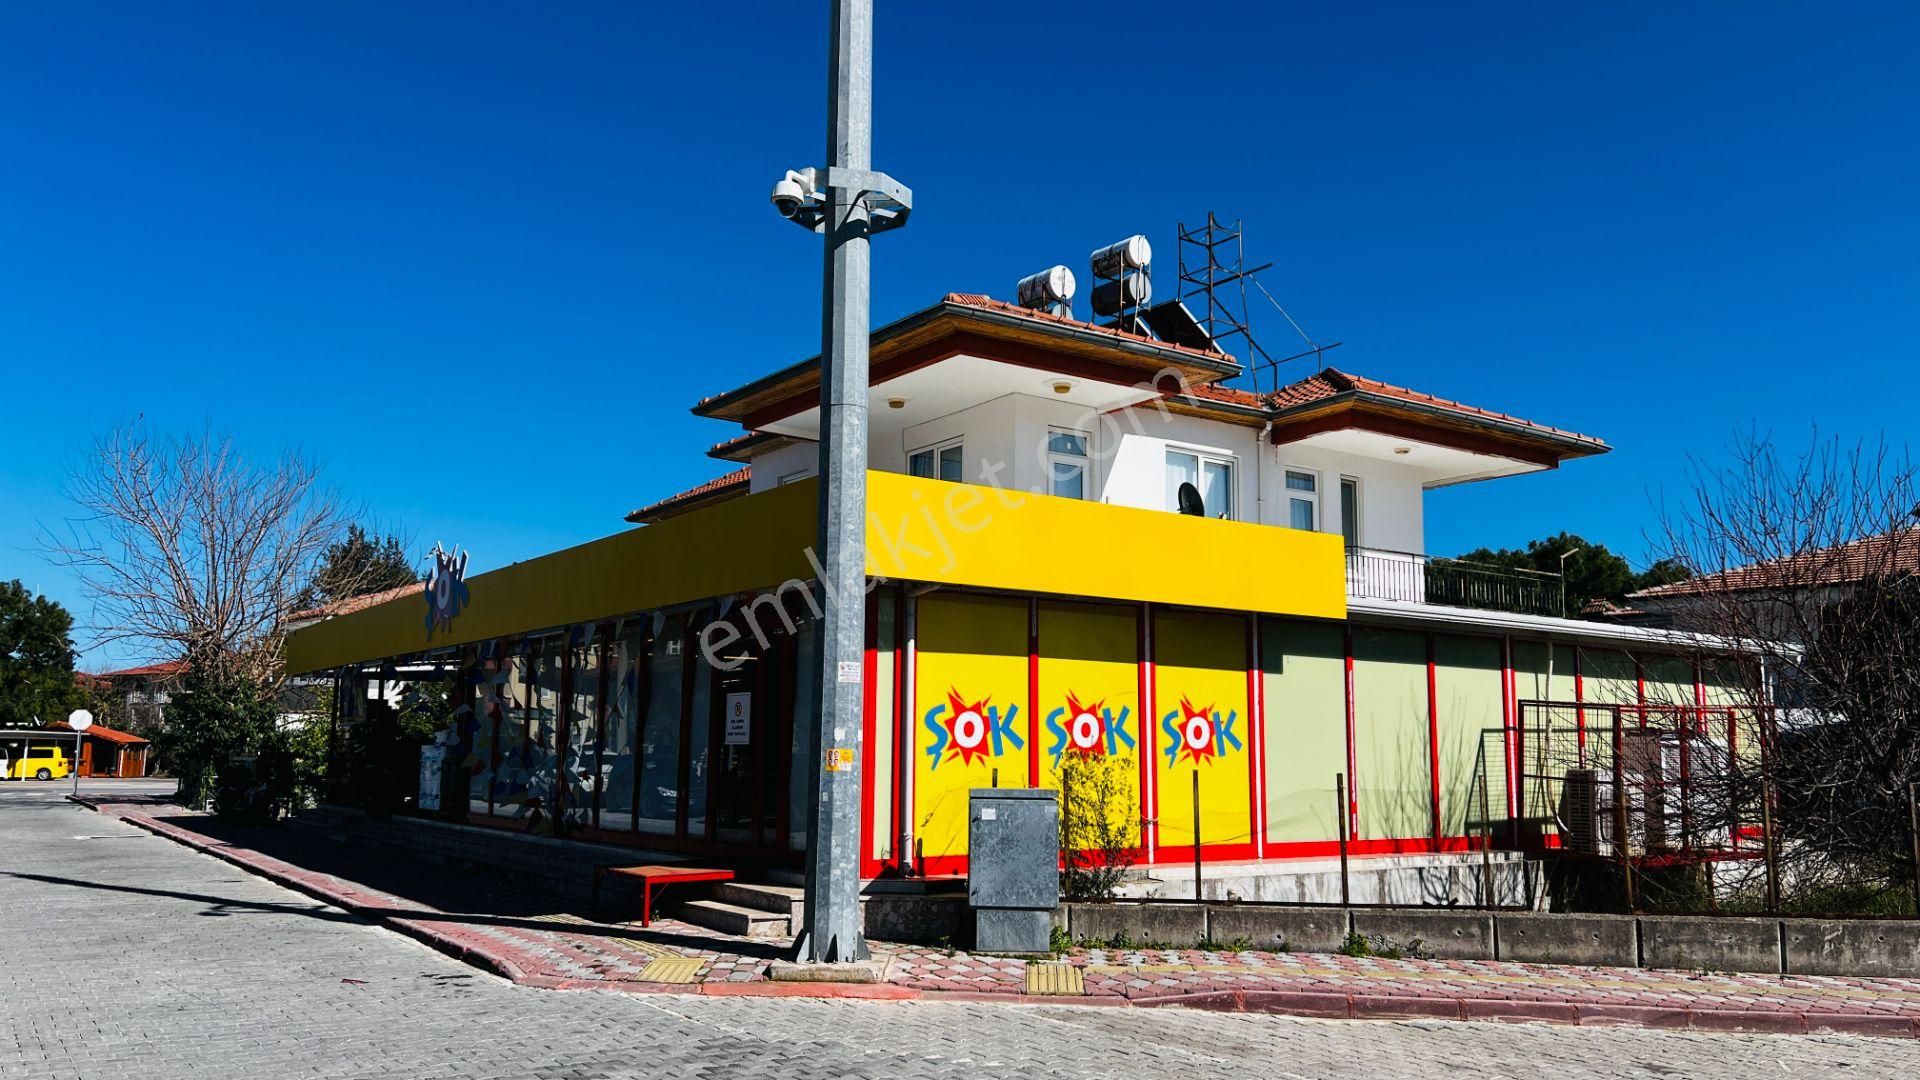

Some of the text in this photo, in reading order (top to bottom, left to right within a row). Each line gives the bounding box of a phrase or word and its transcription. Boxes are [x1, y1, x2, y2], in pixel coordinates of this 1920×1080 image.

[924, 703, 1025, 771] ŞOK
[1046, 705, 1137, 770] ŞOK
[1162, 709, 1244, 770] ŞOK
